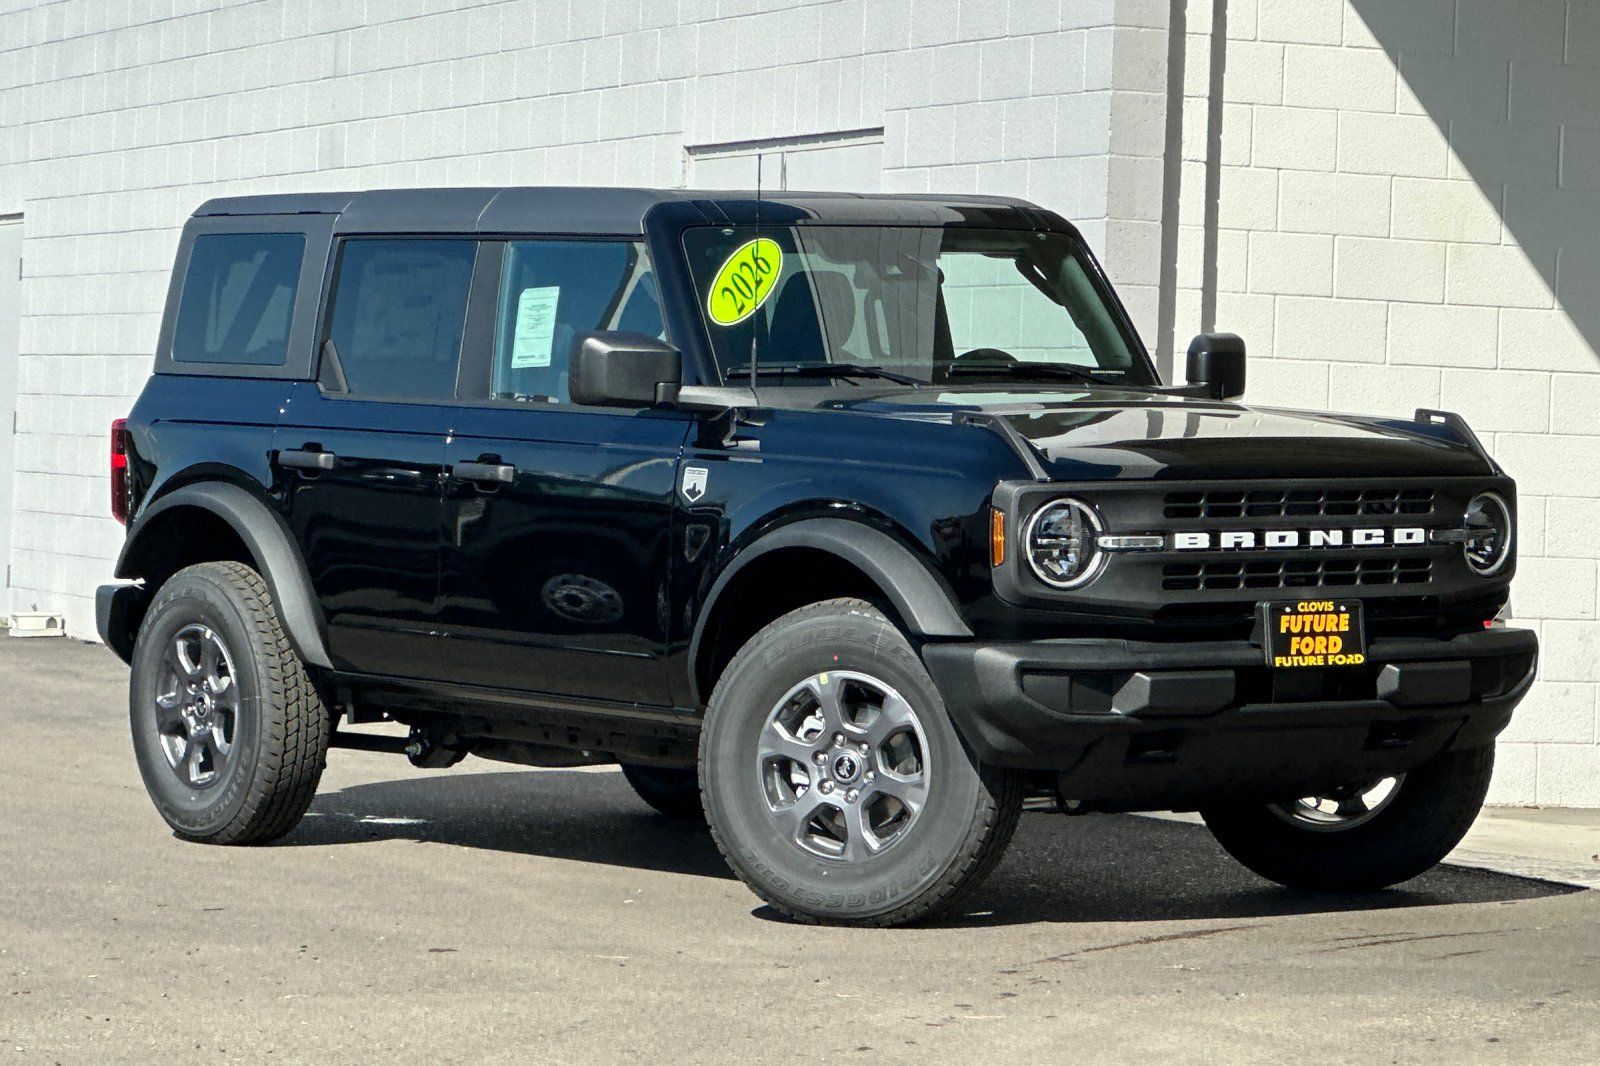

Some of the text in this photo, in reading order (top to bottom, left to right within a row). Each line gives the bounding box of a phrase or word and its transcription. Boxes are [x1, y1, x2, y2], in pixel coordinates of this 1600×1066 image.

[721, 245, 771, 316] 2026
[1174, 528, 1425, 550] BRONCO
[1297, 601, 1334, 612] CLOVIS
[1280, 613, 1350, 634] FUTURE
[1290, 635, 1343, 656] FORD
[1274, 653, 1365, 667] FUTURE FORD
